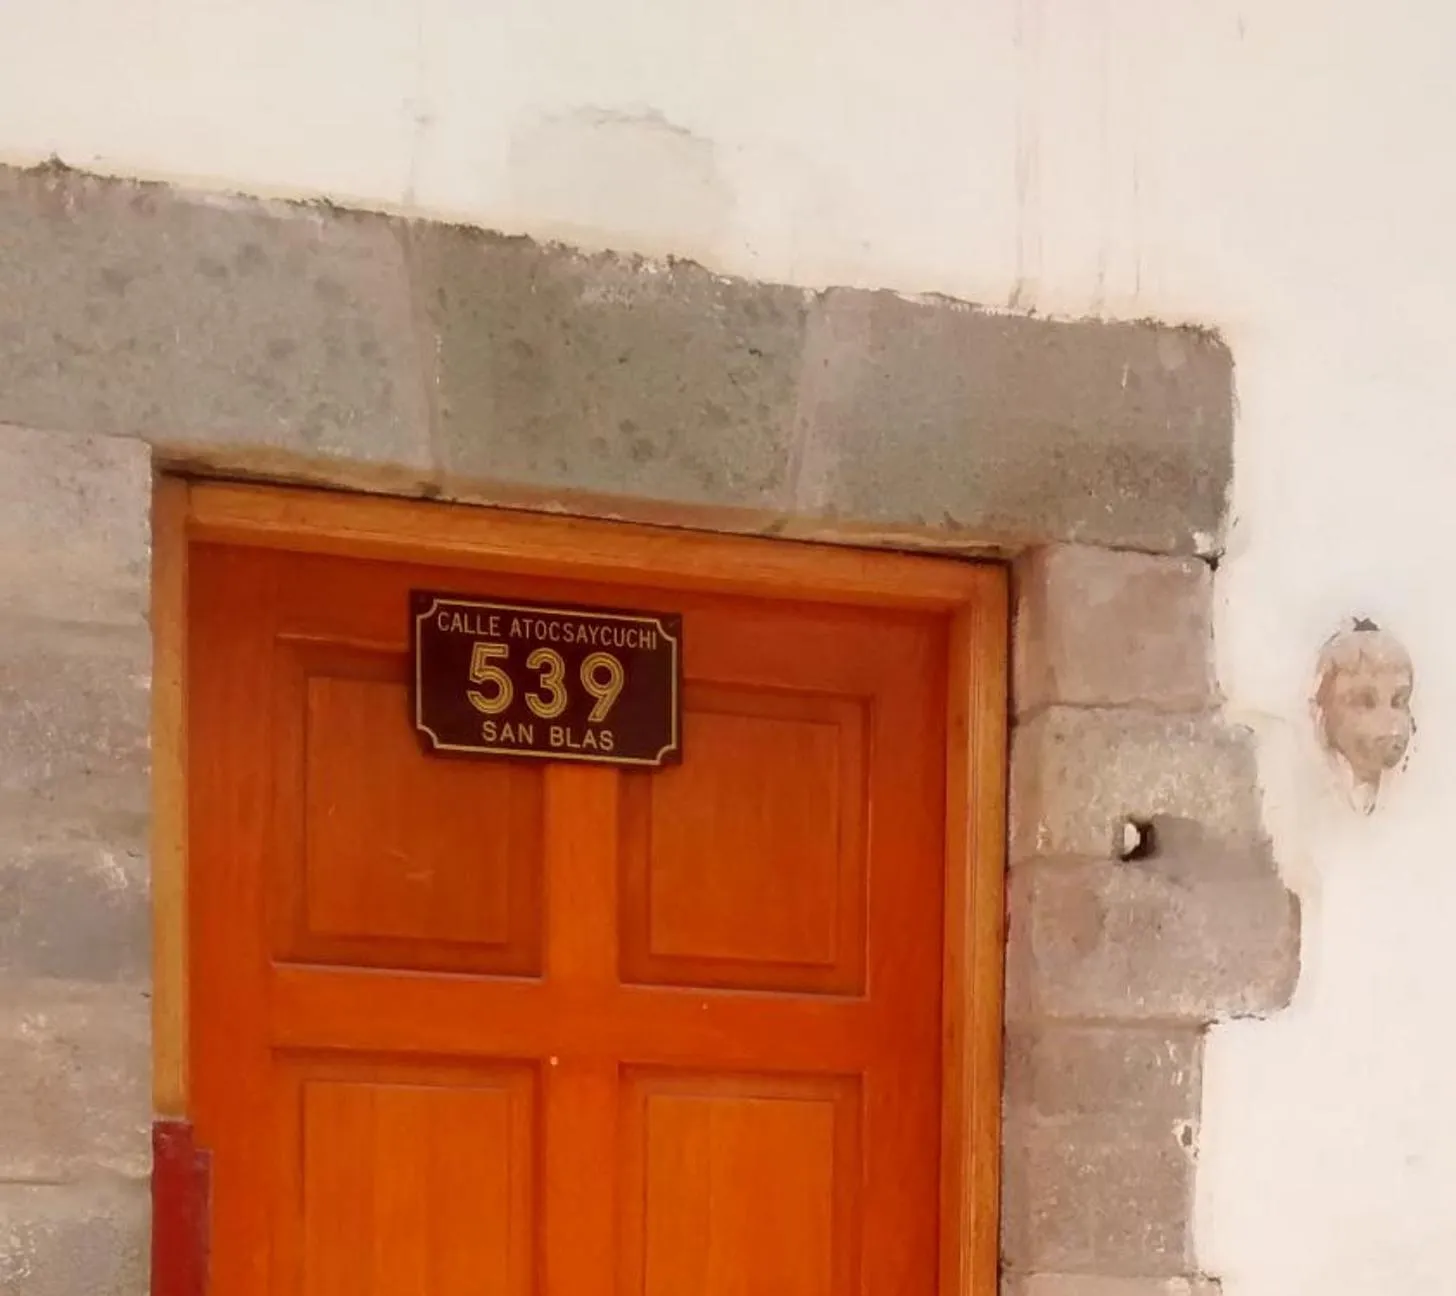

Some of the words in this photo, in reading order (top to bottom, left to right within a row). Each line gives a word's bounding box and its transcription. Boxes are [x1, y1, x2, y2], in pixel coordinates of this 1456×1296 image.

[437, 612, 500, 637] CALLE
[509, 618, 658, 650] ATOCSAYCUCHI
[467, 641, 625, 722] 539
[482, 720, 534, 745] SAN
[550, 726, 615, 751] BLAS
